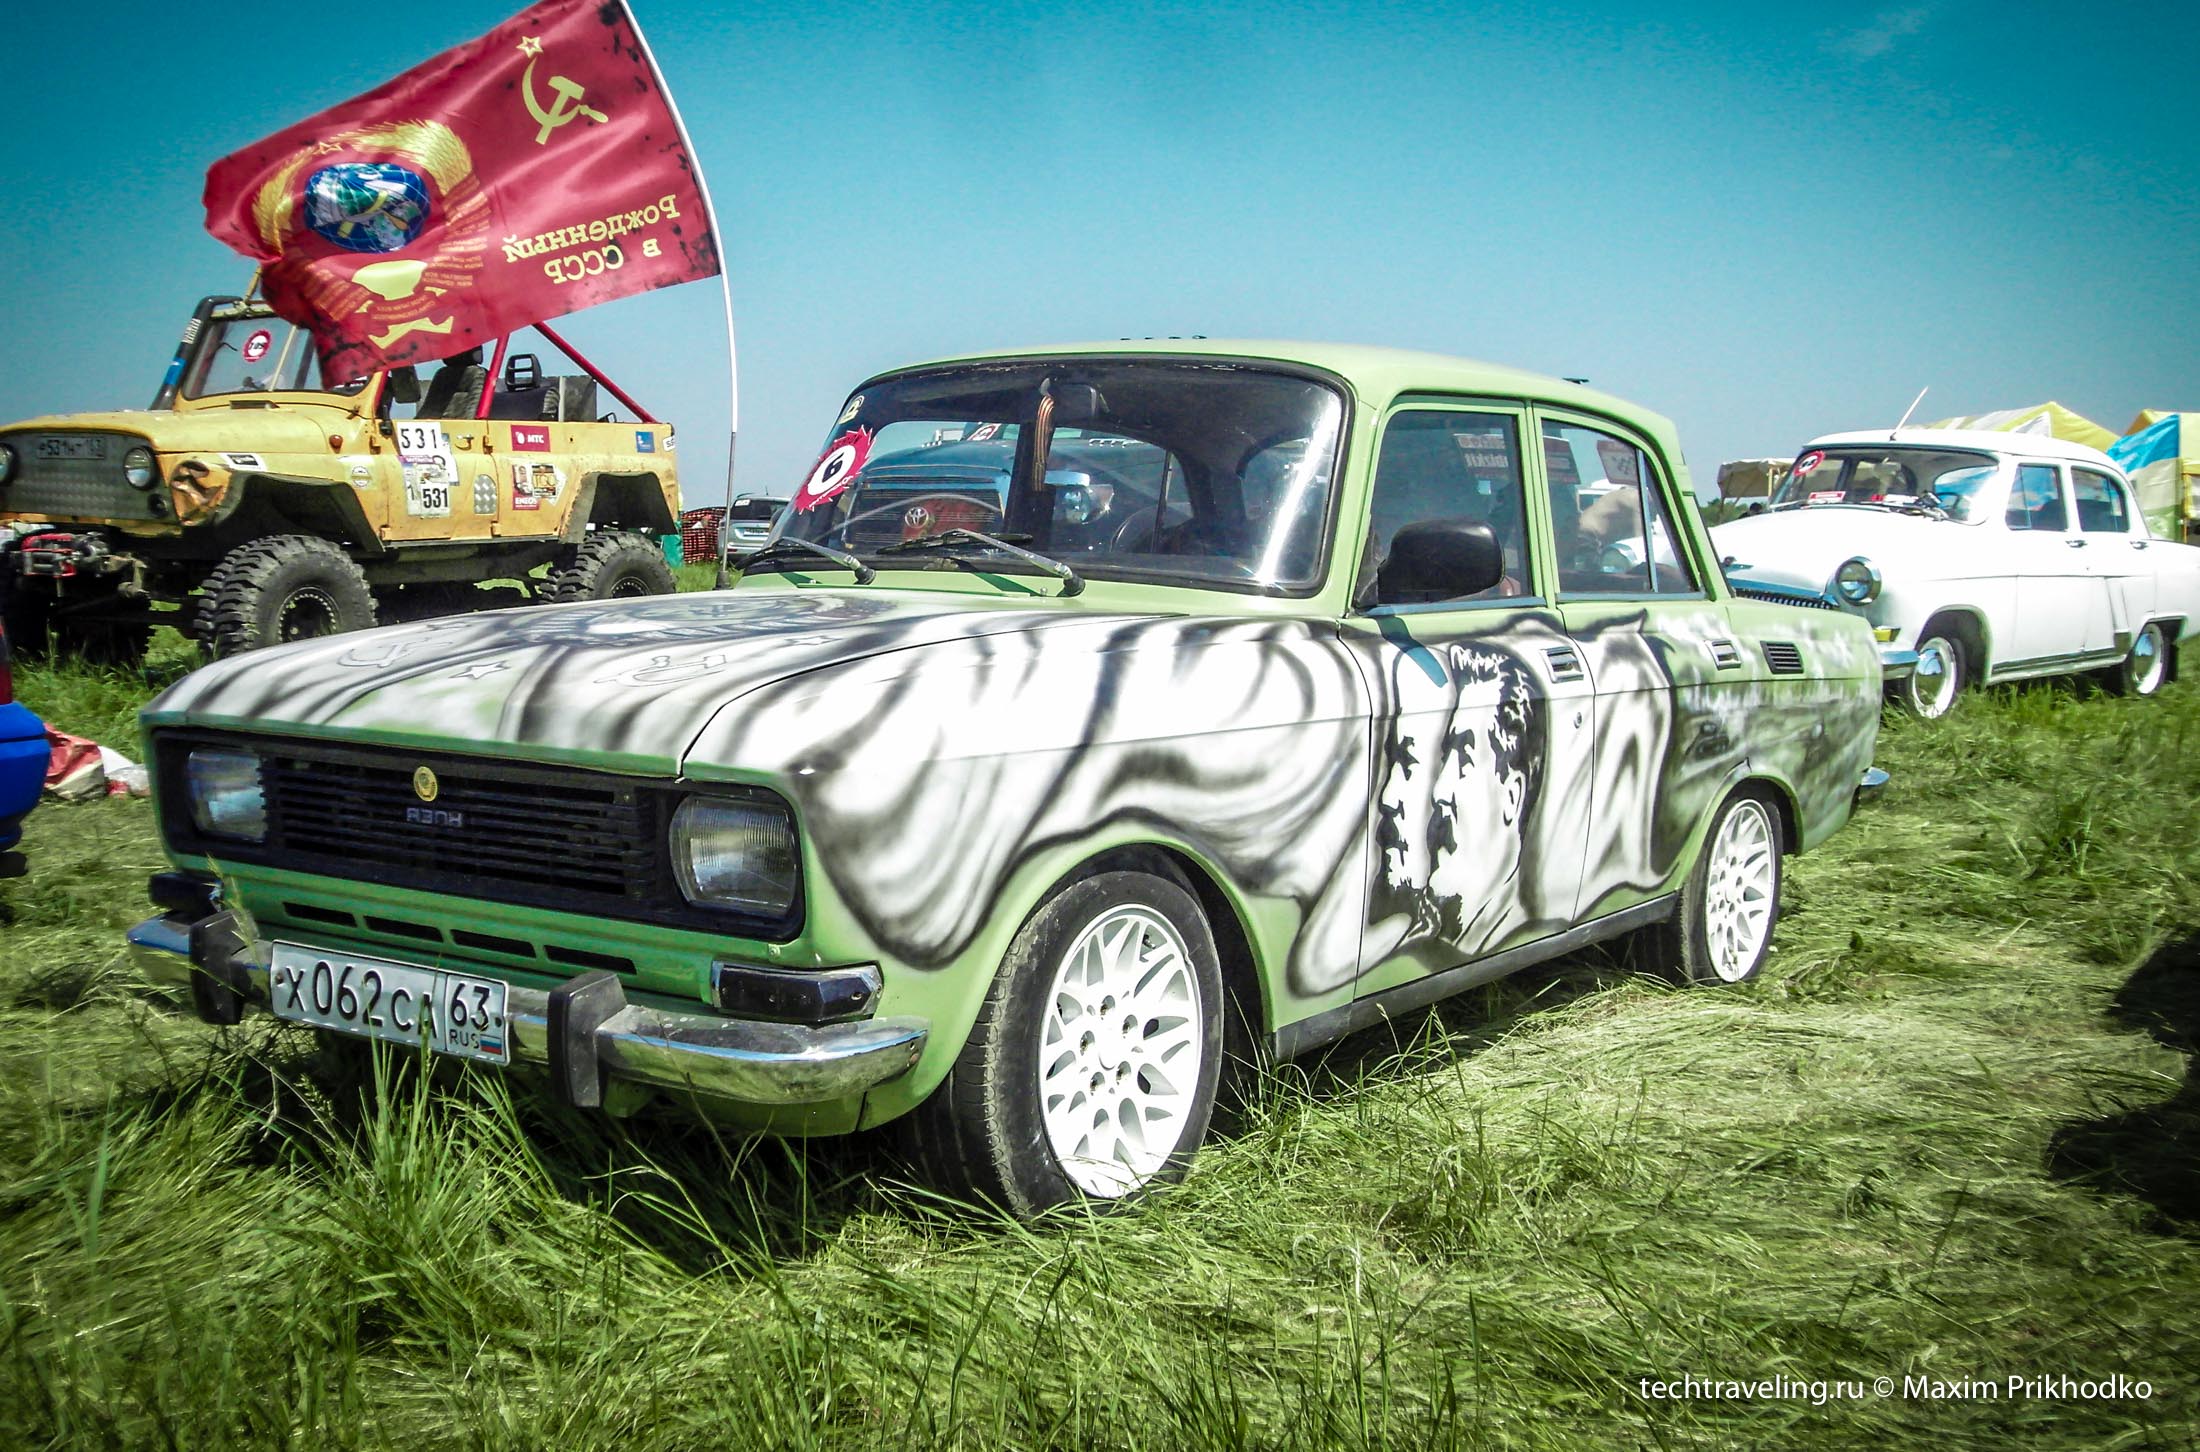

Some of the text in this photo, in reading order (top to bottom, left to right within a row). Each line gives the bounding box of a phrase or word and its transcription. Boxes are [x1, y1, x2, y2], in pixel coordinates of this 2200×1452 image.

[400, 428, 437, 449] 531
[822, 451, 844, 483] 6
[423, 487, 448, 509] 531
[451, 982, 491, 1032] 63
[449, 1028, 480, 1049] RUS
